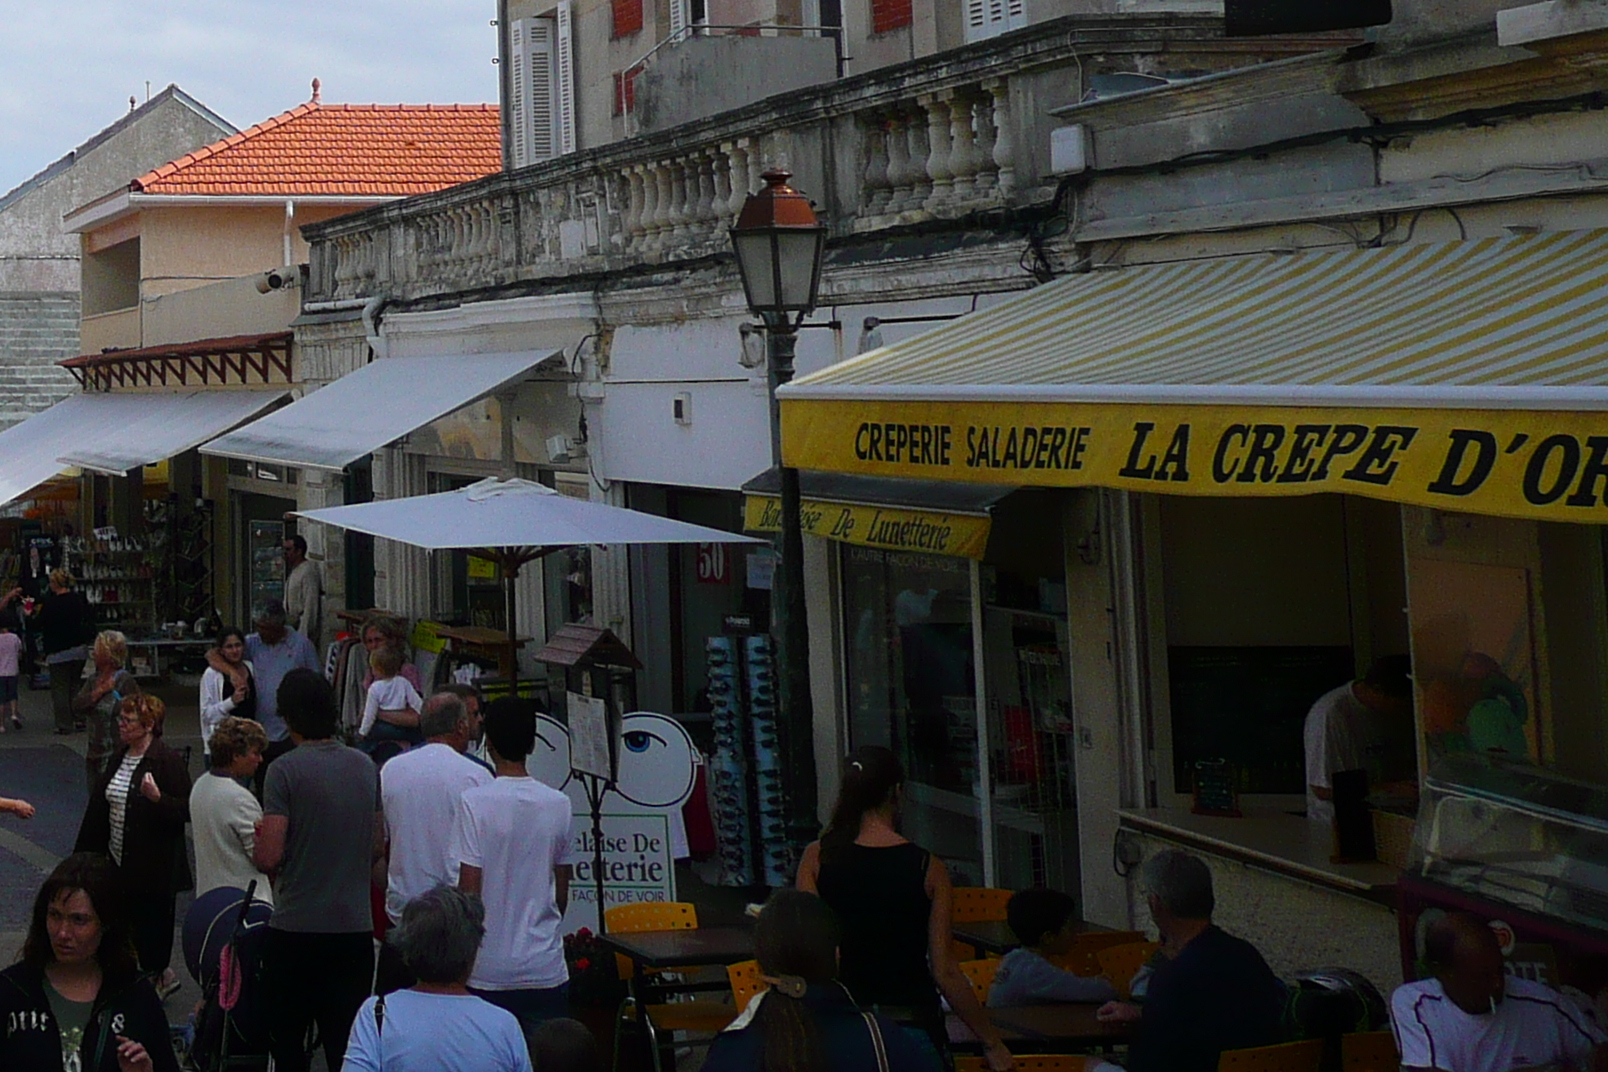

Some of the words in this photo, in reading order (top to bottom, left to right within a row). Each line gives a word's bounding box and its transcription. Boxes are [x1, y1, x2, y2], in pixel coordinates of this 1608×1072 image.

[854, 421, 952, 466] CREPERIE
[966, 426, 1092, 470] SALADERIE
[1118, 421, 1191, 483] LA
[1212, 423, 1419, 486] CREPE
[830, 508, 855, 540] De
[866, 509, 952, 551] Lunetterie
[633, 833, 661, 853] De
[618, 891, 633, 903] DE
[636, 891, 665, 903] VOIR
